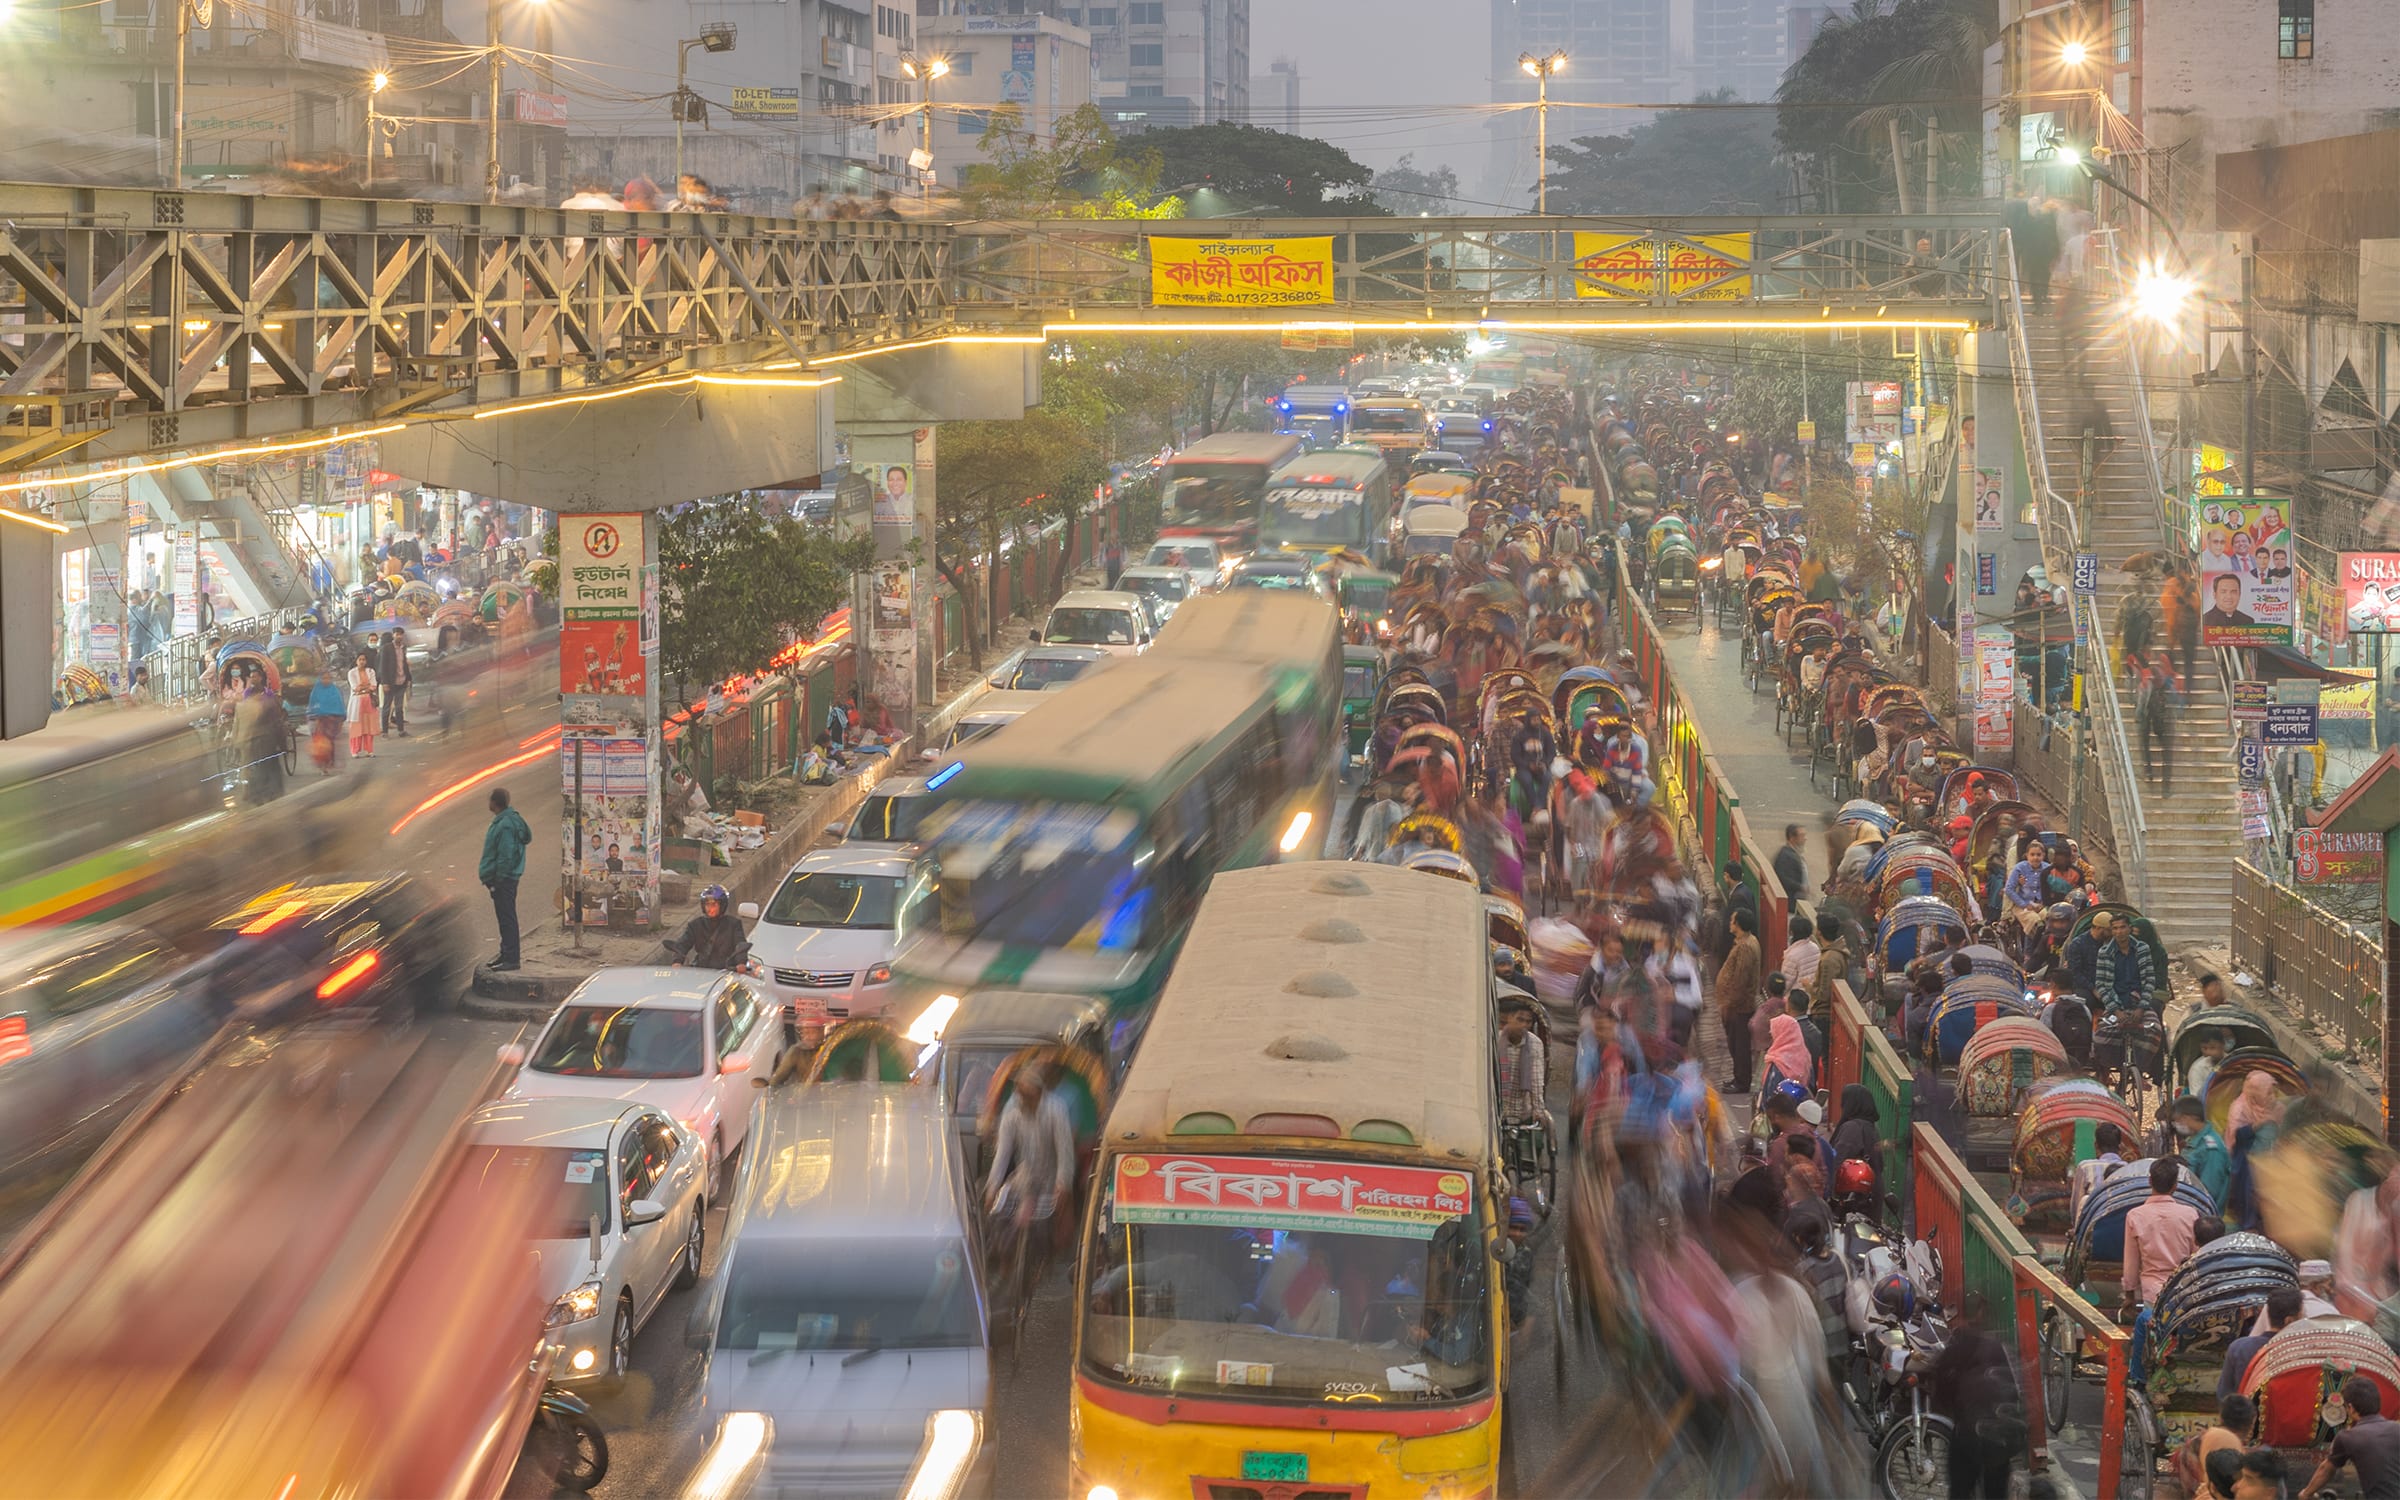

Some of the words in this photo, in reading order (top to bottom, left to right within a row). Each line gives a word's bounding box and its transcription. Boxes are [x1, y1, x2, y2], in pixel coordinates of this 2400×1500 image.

[734, 88, 769, 99] TO-LET
[759, 101, 797, 110] Showroom
[1164, 256, 1232, 289] কাজী
[1238, 255, 1323, 288] অফিস
[573, 563, 631, 583] ইউটার্ন
[2075, 559, 2089, 588] UCC
[2351, 558, 2400, 578] SURA
[577, 585, 628, 600] নিষেধ
[2269, 721, 2311, 735] ধন্যবাদ
[2240, 744, 2257, 779] UCC
[1153, 1160, 1364, 1213] বিকাশ
[1358, 1188, 1429, 1208] পরিবহন
